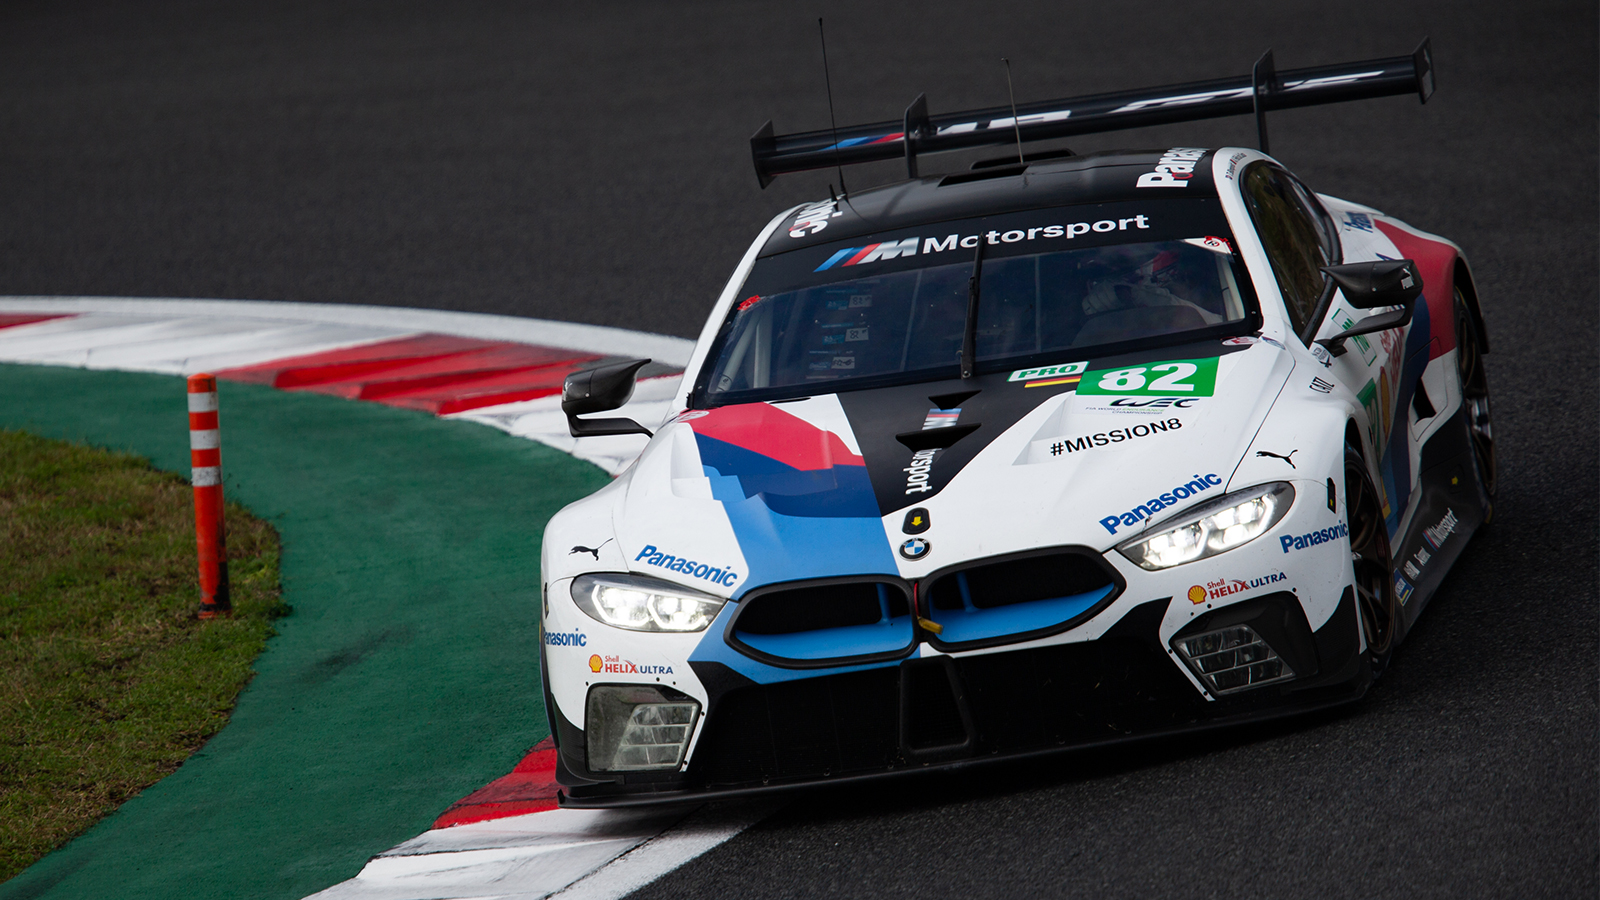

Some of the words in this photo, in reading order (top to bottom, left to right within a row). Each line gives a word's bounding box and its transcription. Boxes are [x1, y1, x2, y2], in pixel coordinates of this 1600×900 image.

[922, 214, 1150, 254] Motorsport
[1018, 364, 1079, 378] PRO
[1098, 363, 1198, 392] 82
[1109, 398, 1199, 409] WEC
[1050, 417, 1183, 456] #MISSION8
[1099, 471, 1222, 536] Panasonic
[1279, 519, 1349, 554] Panasonic
[635, 544, 738, 587] Panasonic
[1207, 578, 1226, 590] Shell
[1209, 579, 1251, 600] HELIX
[1248, 571, 1288, 589] ULTRA
[604, 655, 620, 663] Shell
[604, 660, 638, 674] HELIX
[639, 665, 674, 675] ULTRA
